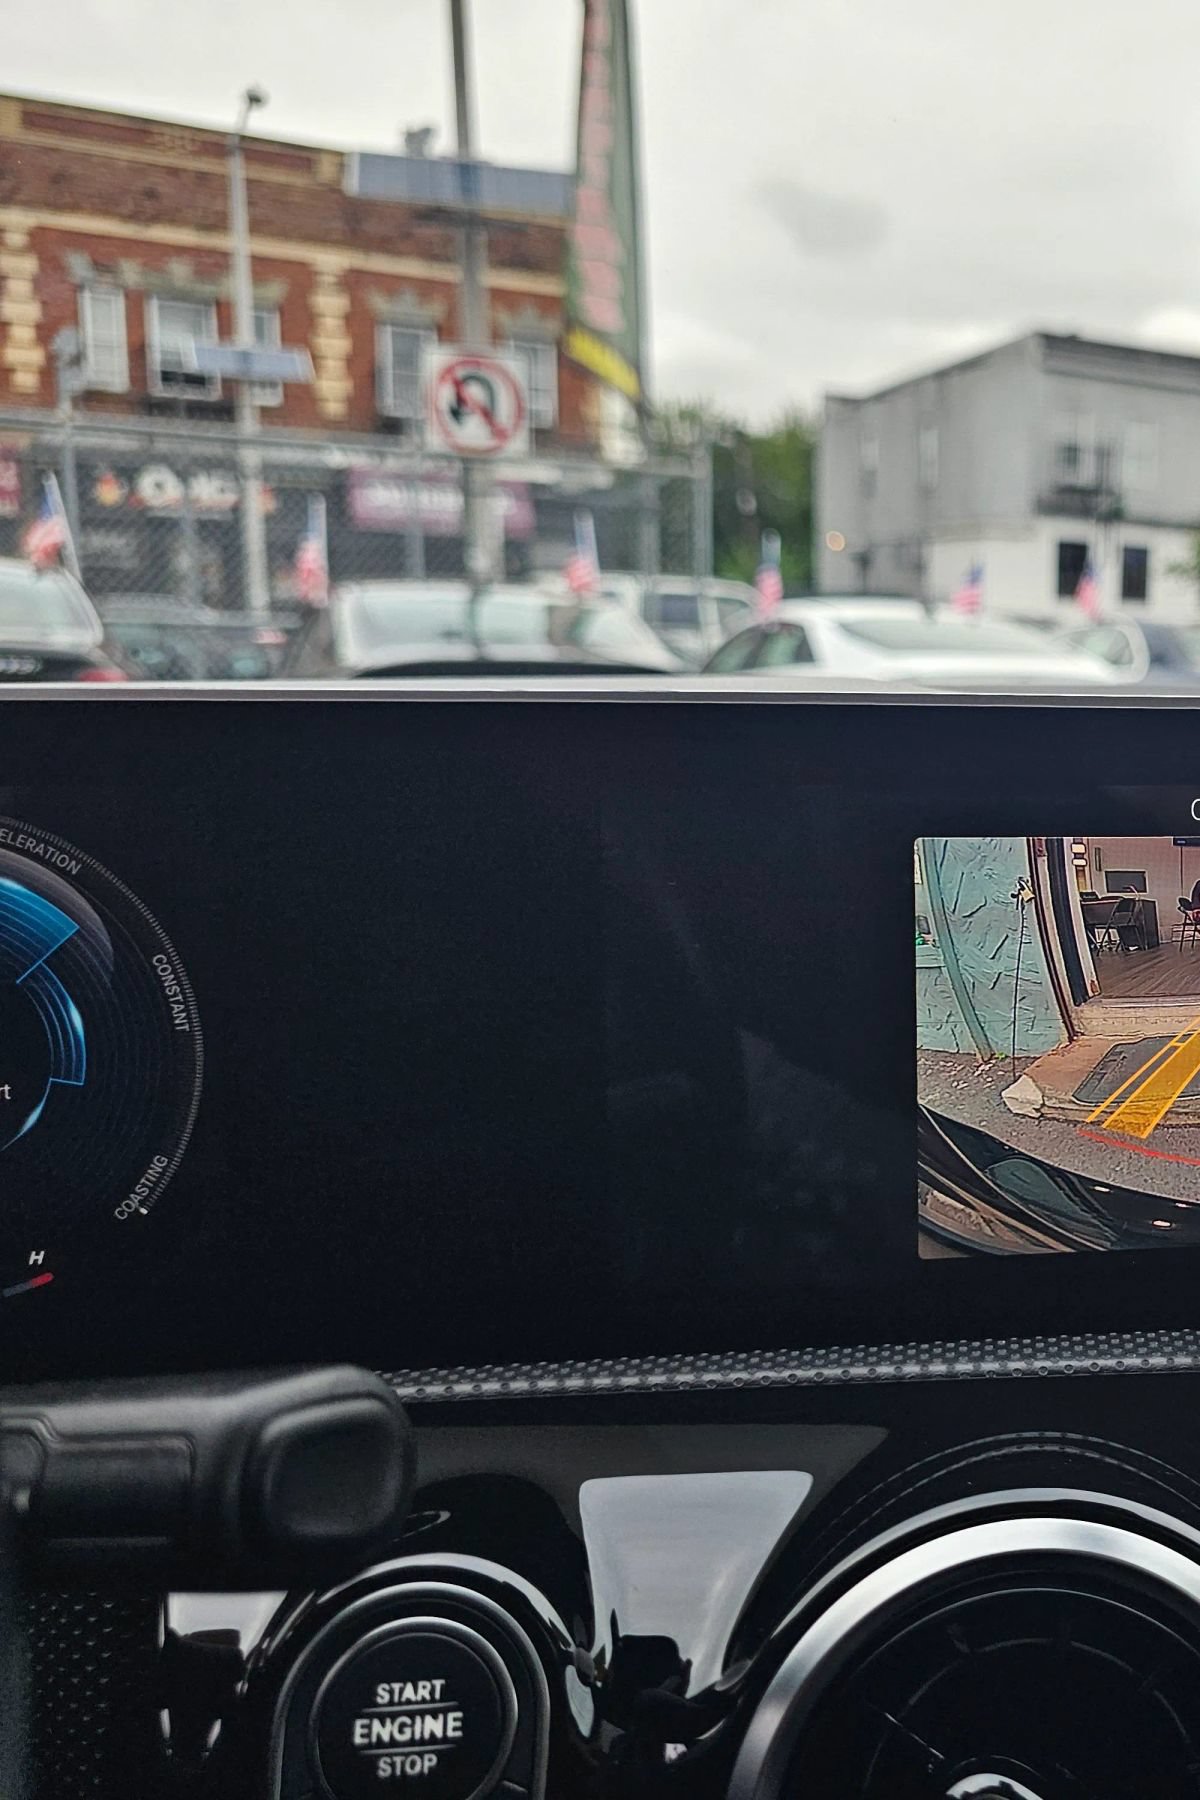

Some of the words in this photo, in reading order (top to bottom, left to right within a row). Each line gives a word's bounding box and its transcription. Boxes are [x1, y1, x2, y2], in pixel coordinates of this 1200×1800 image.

[152, 954, 190, 1032] CONSTANT
[114, 1154, 169, 1220] COASTING
[28, 1250, 45, 1265] H
[375, 1679, 446, 1704] START
[353, 1711, 464, 1746] ENGINE
[376, 1753, 438, 1779] STOP
